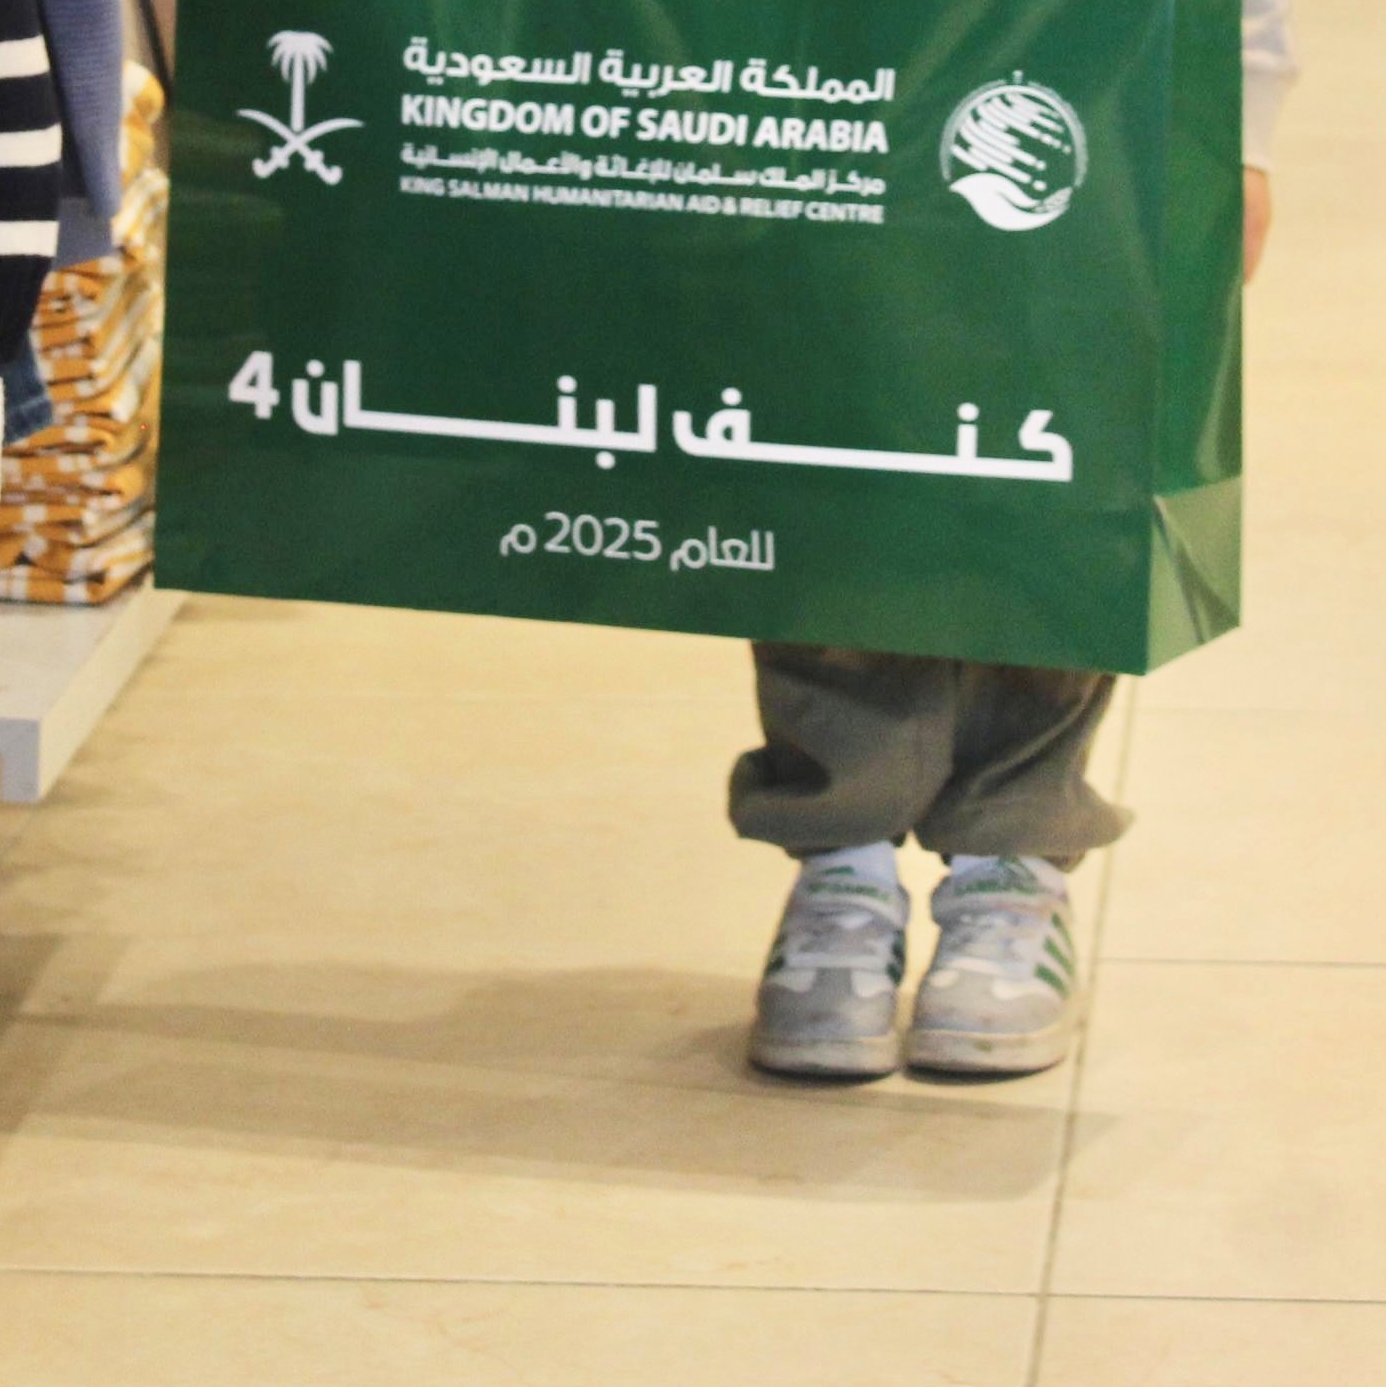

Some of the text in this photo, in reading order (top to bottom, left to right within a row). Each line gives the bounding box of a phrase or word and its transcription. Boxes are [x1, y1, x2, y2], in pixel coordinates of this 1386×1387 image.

[403, 36, 896, 104] المملكة العربية السعودية
[401, 93, 889, 154] KINGDOM OF SAUDI ARABIA
[399, 175, 884, 225] KING SALMAN HUMANITARIAN AID & RELIEF CENTRE
[673, 162, 758, 187] سلمان
[760, 166, 826, 191] الملك
[825, 169, 886, 197] مركز
[227, 350, 280, 420] 4
[291, 358, 658, 470] لبنان
[499, 511, 776, 572] للعام 2025 م
